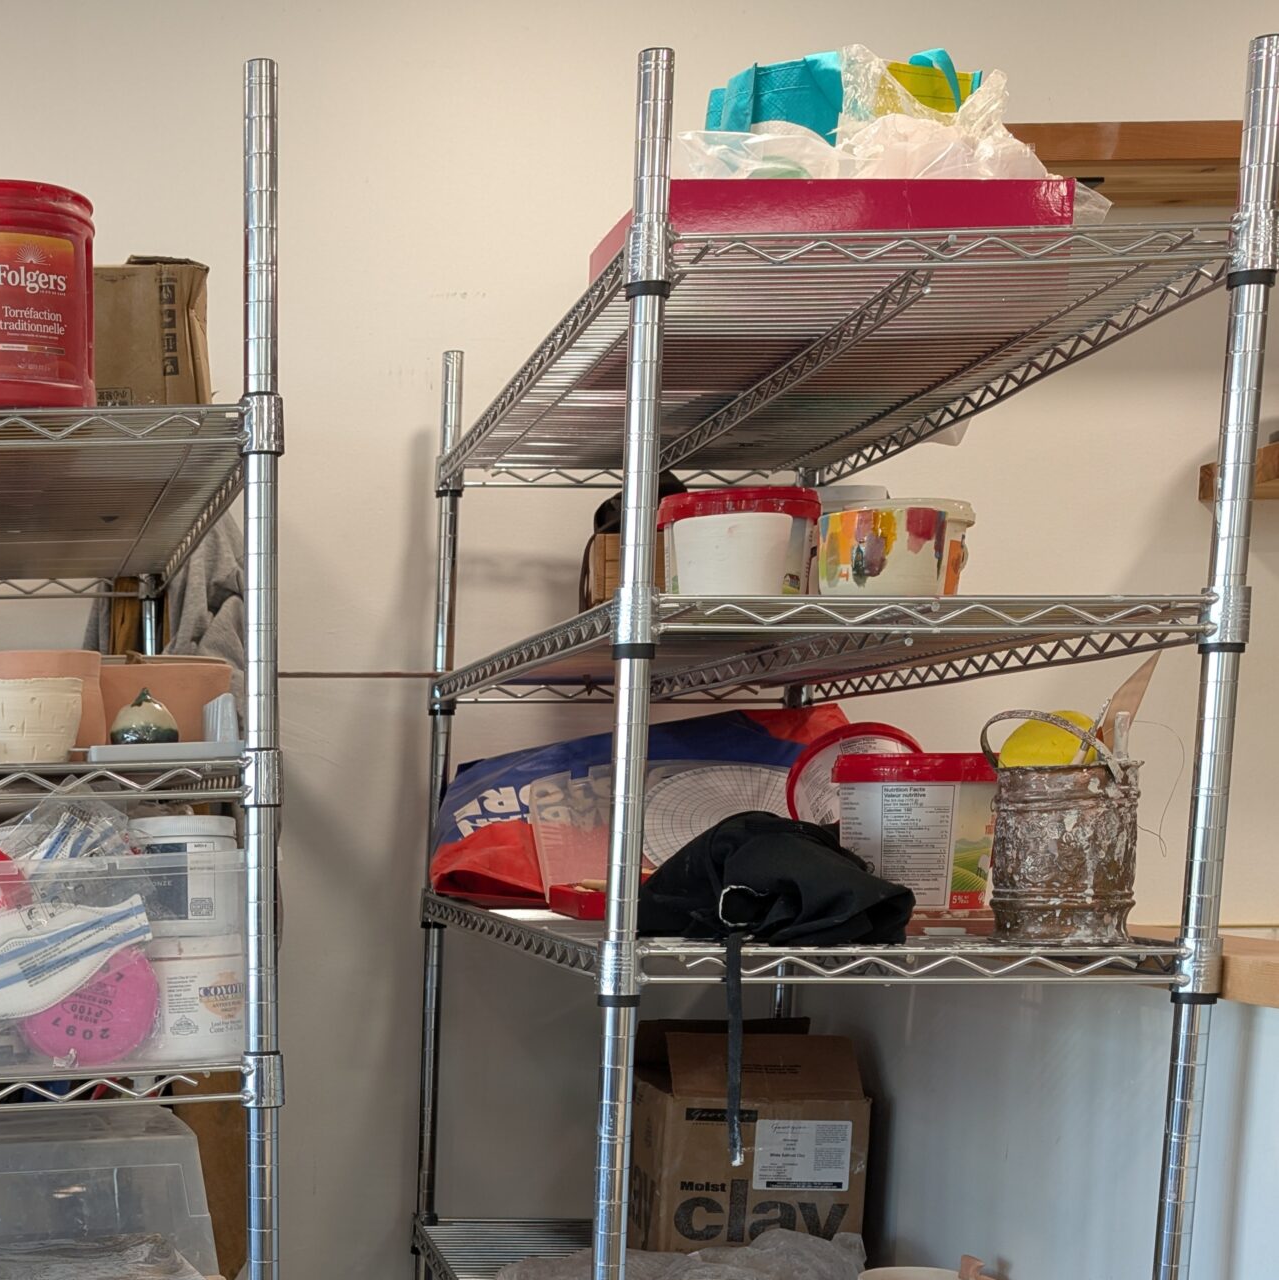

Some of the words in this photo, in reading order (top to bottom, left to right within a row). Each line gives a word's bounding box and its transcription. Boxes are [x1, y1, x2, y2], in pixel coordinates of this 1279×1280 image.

[2, 305, 63, 322] Torréfaction
[0, 319, 66, 336] traditionnelle
[52, 1016, 110, 1040] 2097
[680, 1181, 726, 1193] Moist
[674, 1179, 849, 1243] clay
